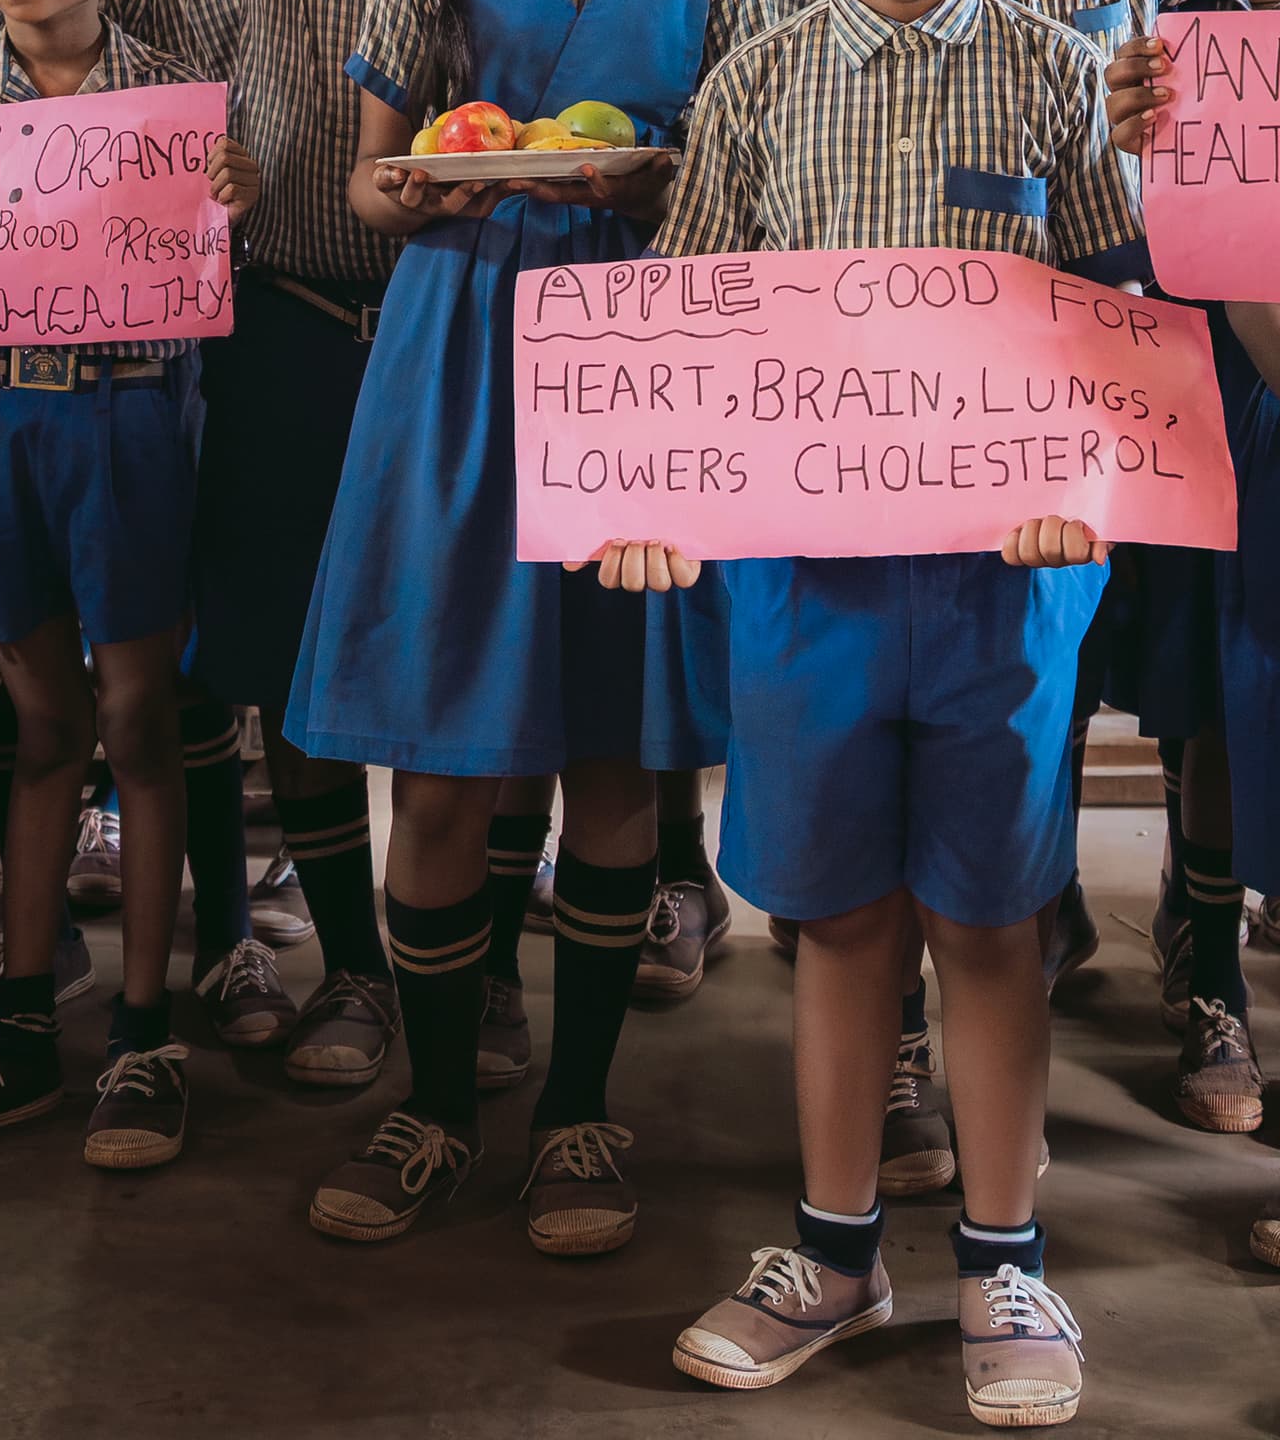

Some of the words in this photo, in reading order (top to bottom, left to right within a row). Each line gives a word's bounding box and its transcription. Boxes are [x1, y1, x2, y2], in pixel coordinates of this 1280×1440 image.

[101, 215, 227, 266] PRESSURE
[1050, 277, 1162, 348] FOR
[541, 440, 748, 494] LOWERS
[794, 429, 1185, 496] CHOLESTEROL
